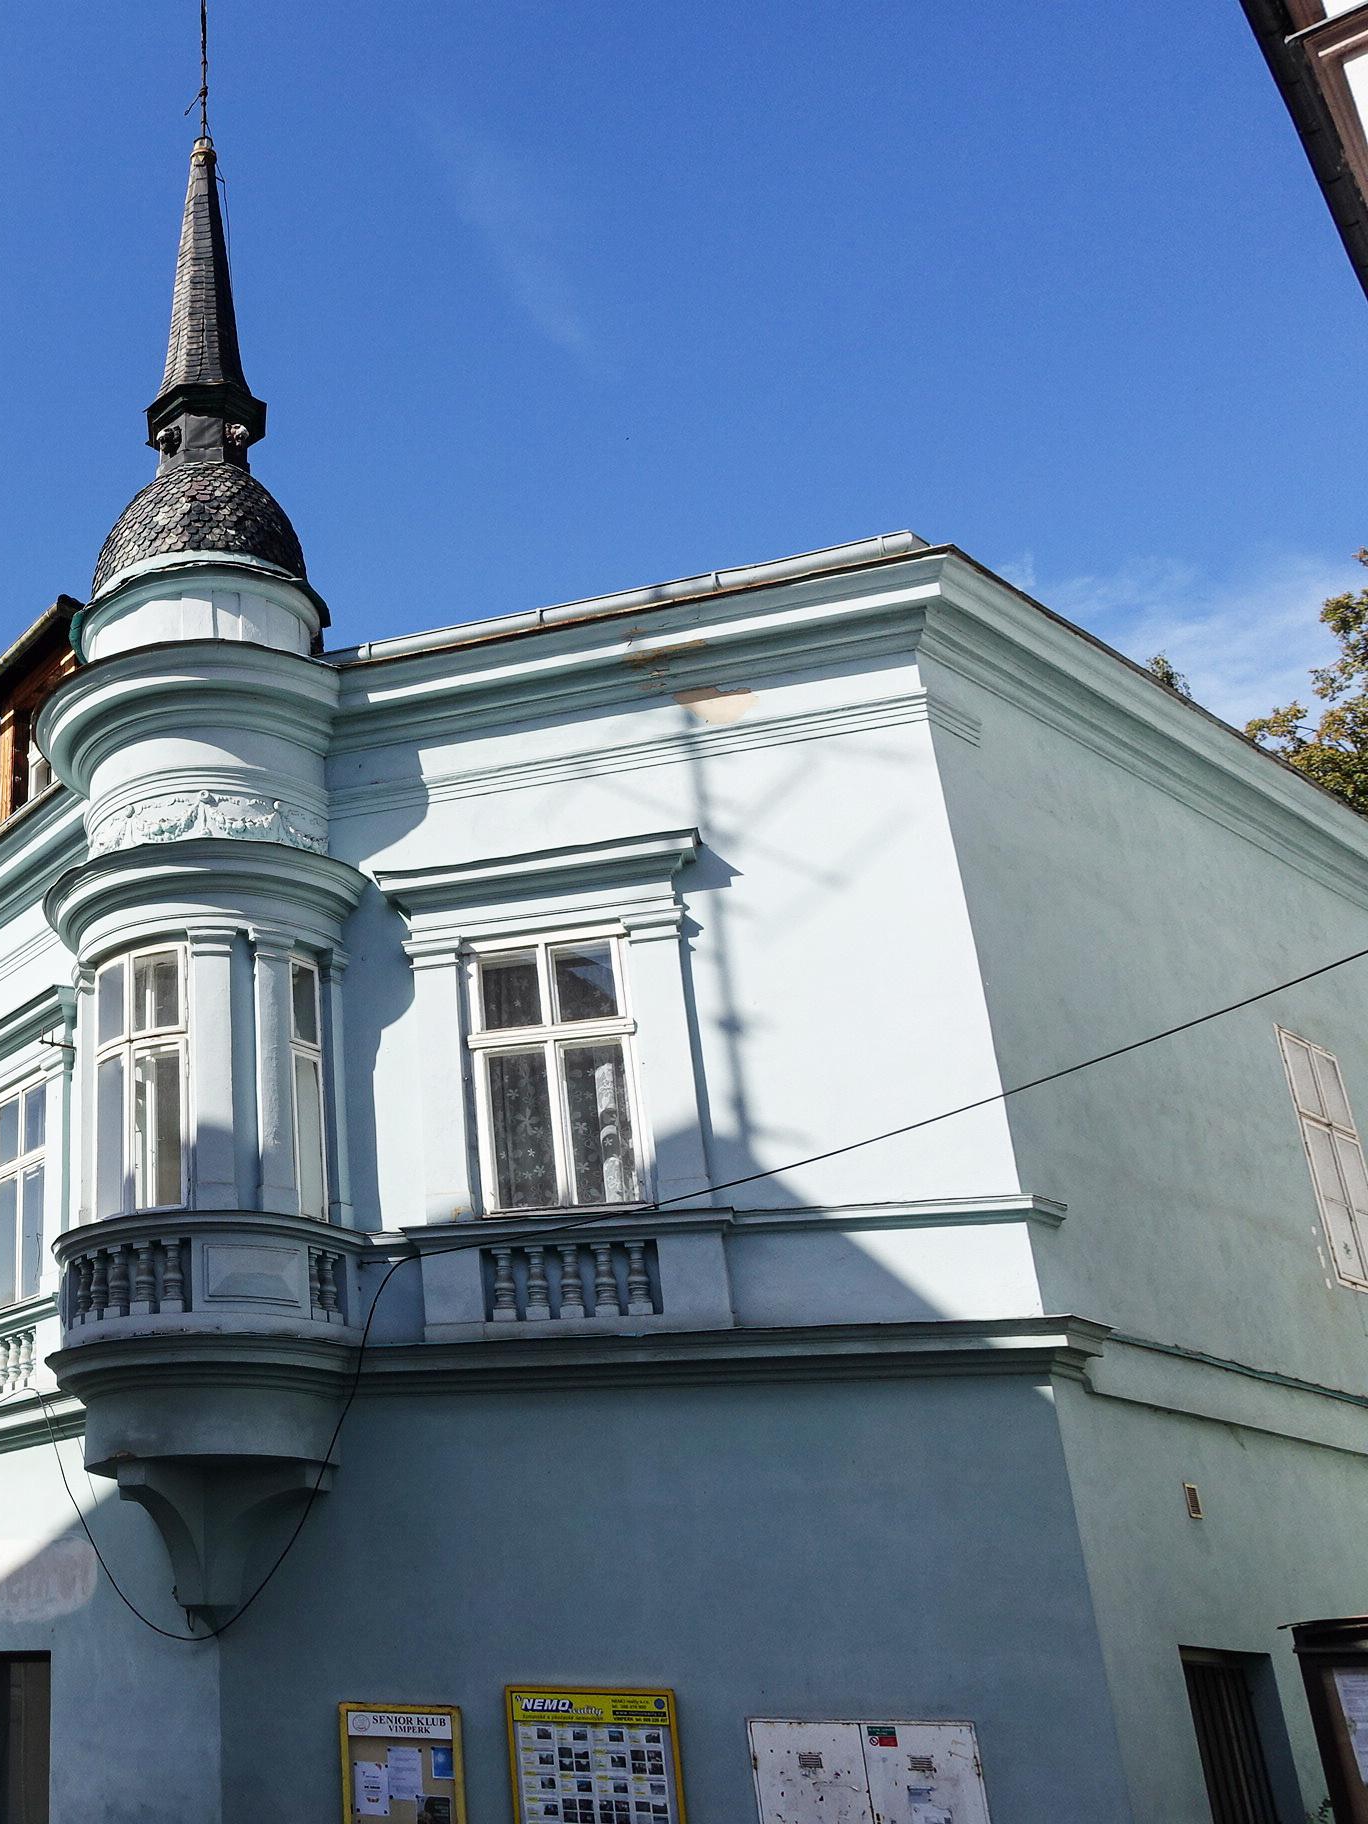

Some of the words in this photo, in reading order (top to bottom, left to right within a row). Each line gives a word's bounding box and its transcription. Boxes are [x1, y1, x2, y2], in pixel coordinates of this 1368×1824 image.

[521, 1698, 572, 1711] NEMO
[372, 1715, 413, 1726] SENIOR
[416, 1717, 446, 1727] KLUB
[388, 1725, 431, 1734] VIMPERK
